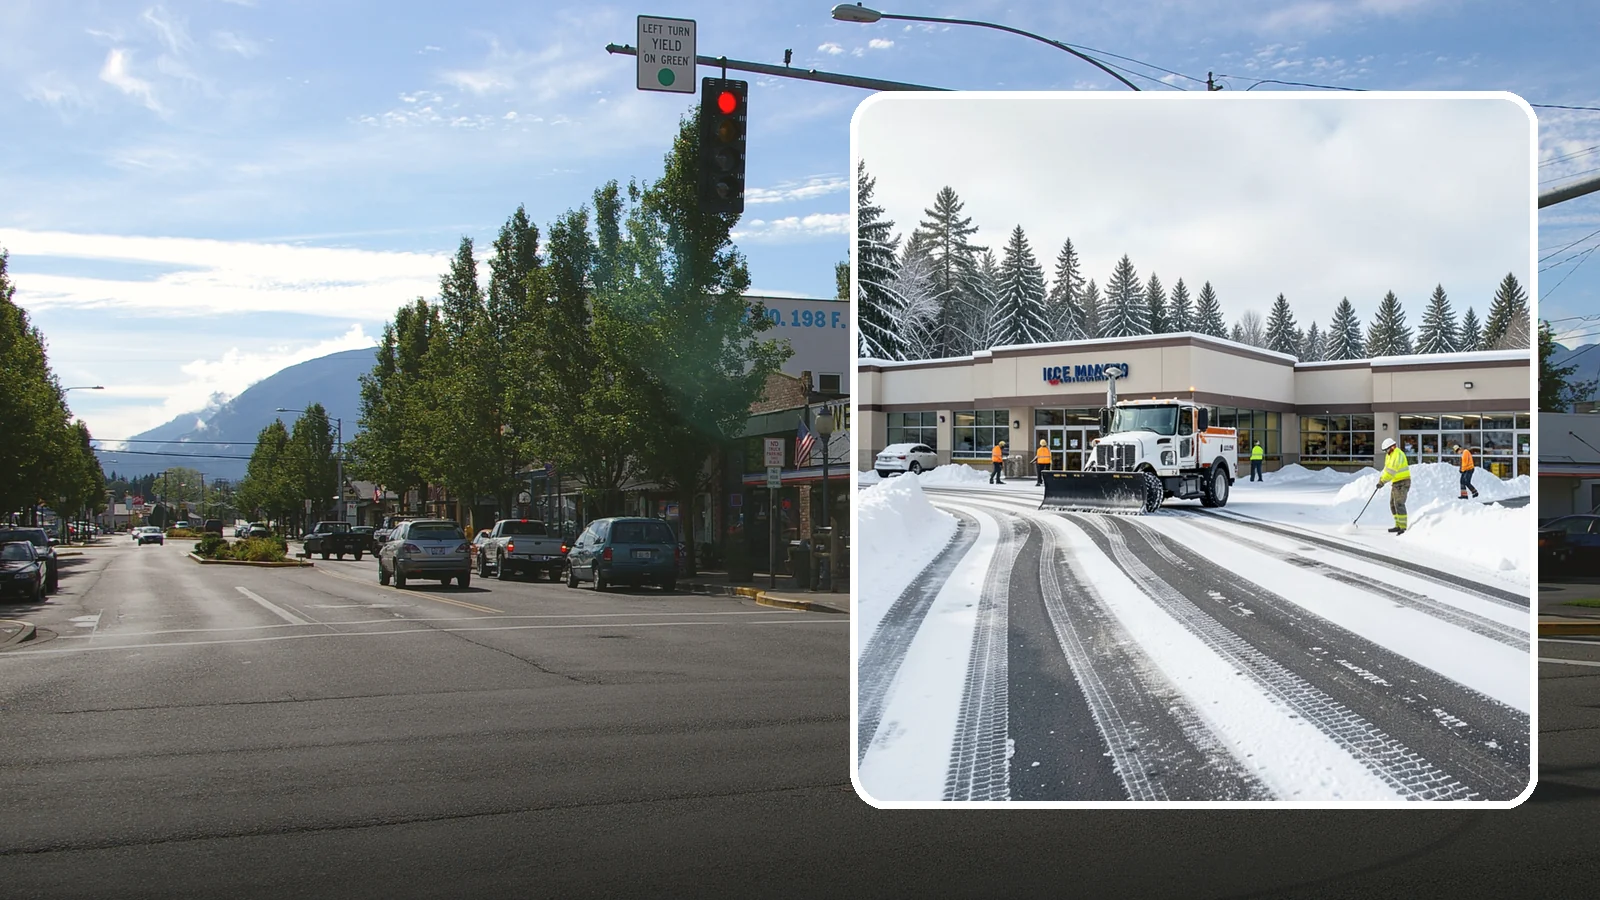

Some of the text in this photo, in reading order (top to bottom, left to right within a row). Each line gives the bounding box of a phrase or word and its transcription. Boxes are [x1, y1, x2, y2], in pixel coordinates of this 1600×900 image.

[642, 23, 690, 36] LEFT TURN
[652, 38, 682, 52] YIELD
[644, 53, 689, 66] ON GREEN
[791, 309, 826, 328] 198
[831, 311, 846, 329] F.
